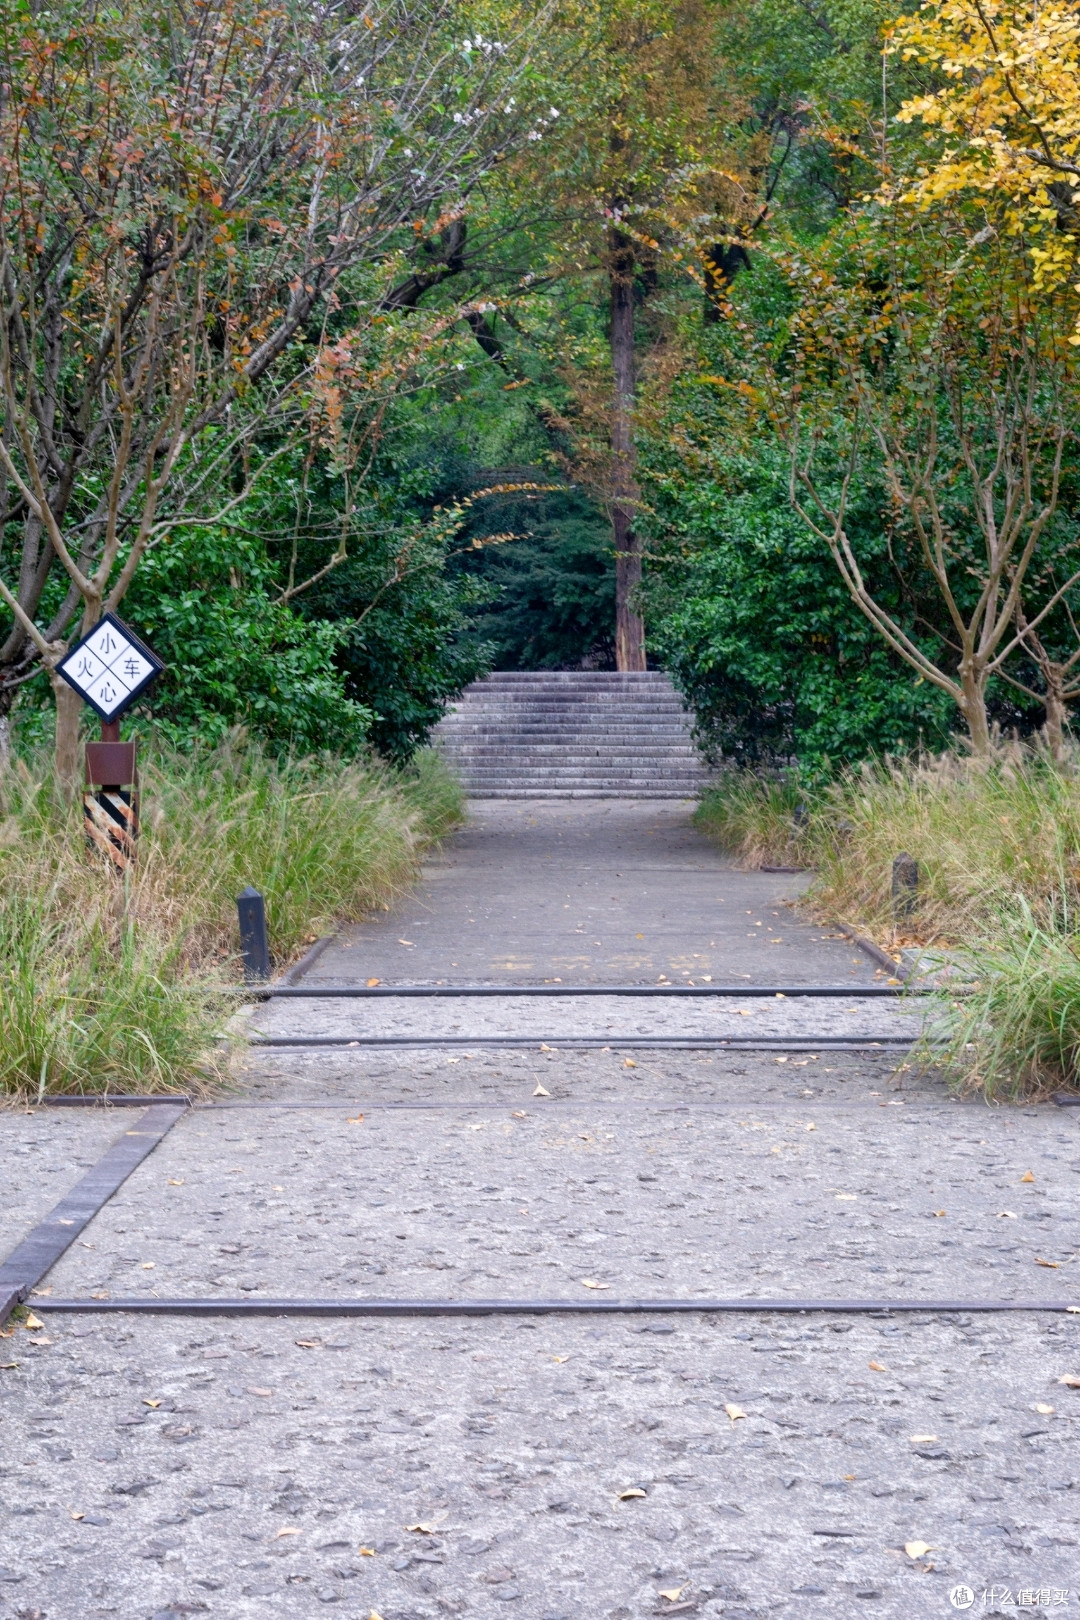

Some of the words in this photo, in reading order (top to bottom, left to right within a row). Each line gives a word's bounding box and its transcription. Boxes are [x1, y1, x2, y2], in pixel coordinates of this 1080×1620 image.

[100, 632, 117, 654] 小
[77, 656, 94, 678] 火
[123, 656, 141, 679] 车
[100, 681, 117, 703] 心
